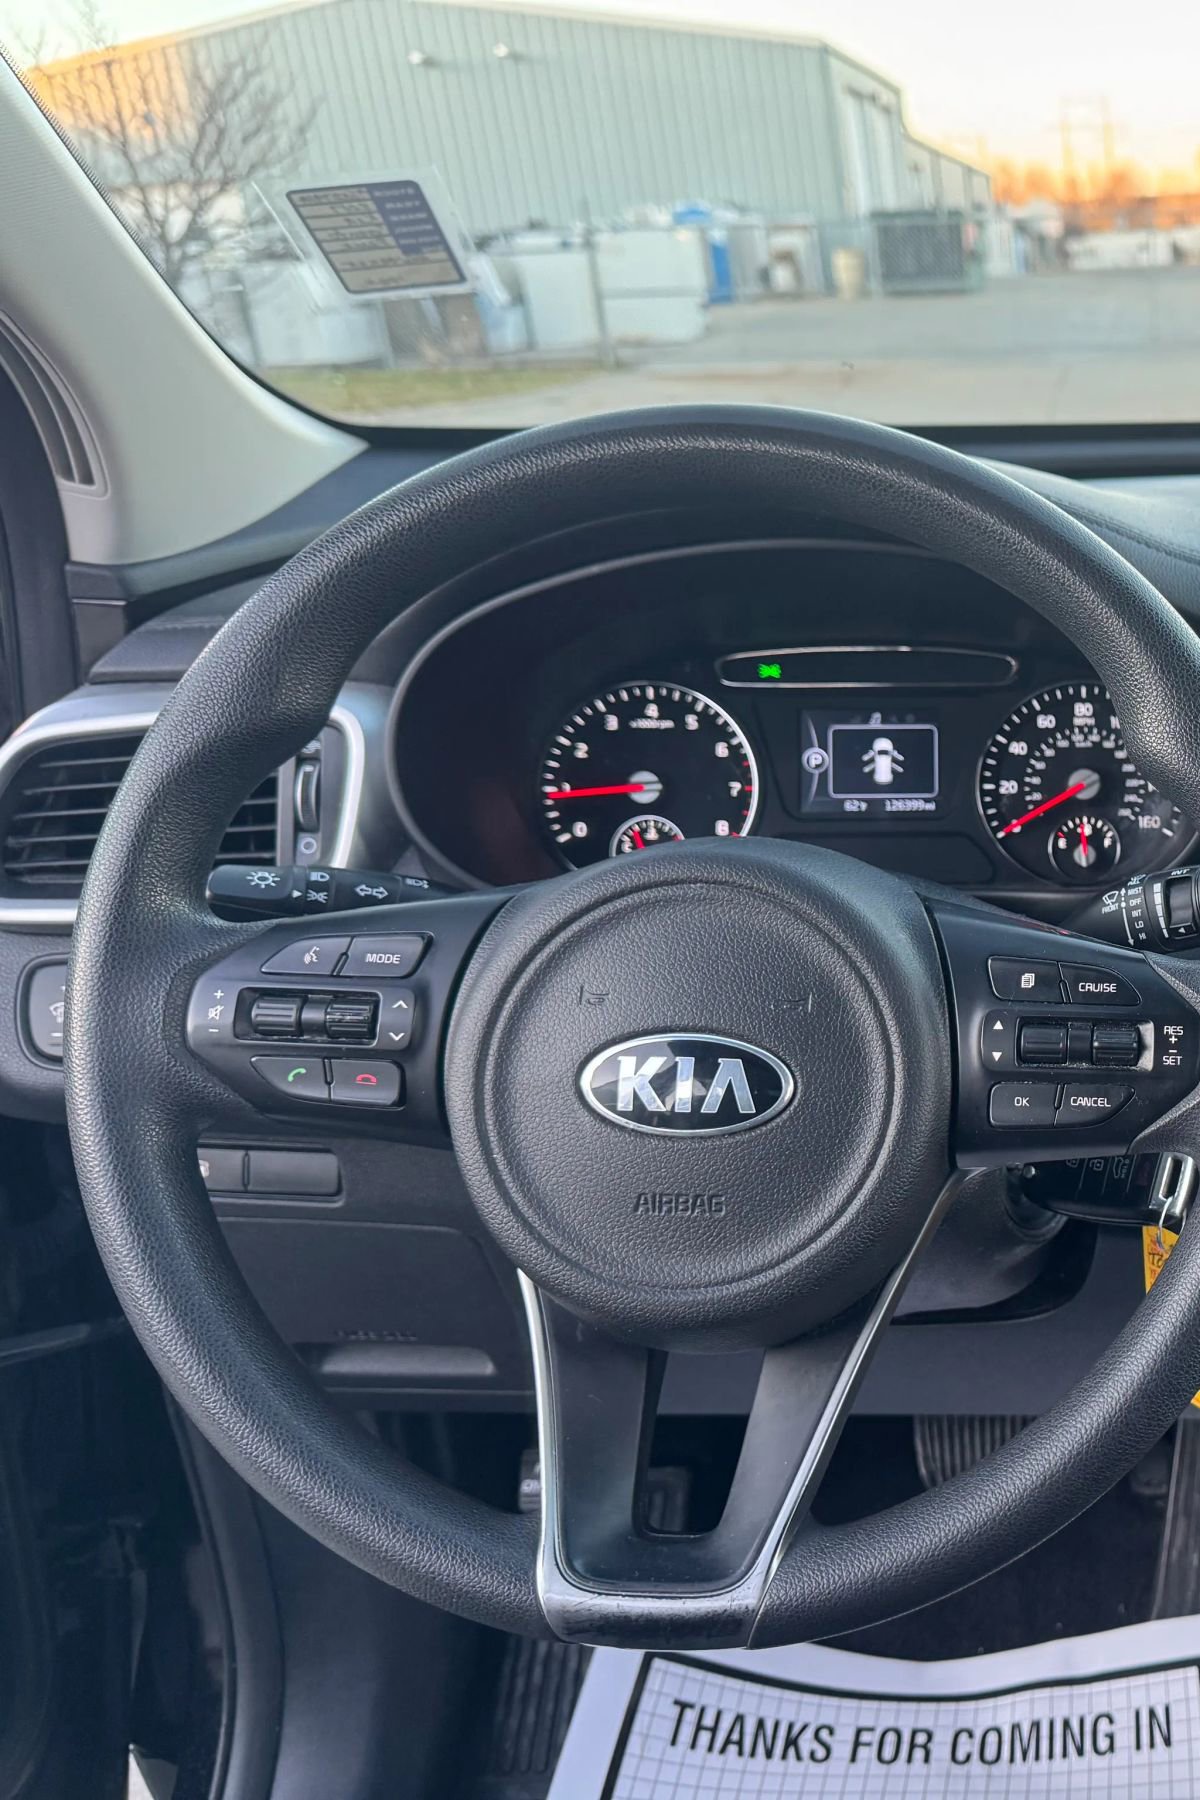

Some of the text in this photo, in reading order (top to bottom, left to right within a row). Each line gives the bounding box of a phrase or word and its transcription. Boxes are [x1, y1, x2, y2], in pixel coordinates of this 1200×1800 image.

[1074, 702, 1093, 717] 80
[604, 714, 618, 731] 3
[685, 714, 699, 731] 5
[1037, 714, 1056, 729] 60
[573, 742, 589, 759] 2
[714, 741, 729, 758] 6
[1008, 741, 1028, 756] 40
[727, 781, 742, 797] 7
[999, 780, 1018, 794] 20
[572, 821, 588, 838] 0
[1101, 903, 1119, 914] FRONT
[1129, 898, 1142, 907] OFF
[1131, 909, 1142, 918] INT
[1134, 920, 1145, 929] LO
[1138, 932, 1147, 941] HI
[365, 953, 401, 964] MODE
[1078, 982, 1117, 993] CRUISE
[1163, 1025, 1184, 1036] RES
[1162, 1056, 1183, 1066] SET
[616, 1055, 756, 1114] KIA
[1014, 1096, 1030, 1107] OK
[1070, 1096, 1111, 1108] CANCEL
[634, 1192, 727, 1216] AIRBAG
[668, 1699, 1173, 1766] THANKS FOR COMING IN
